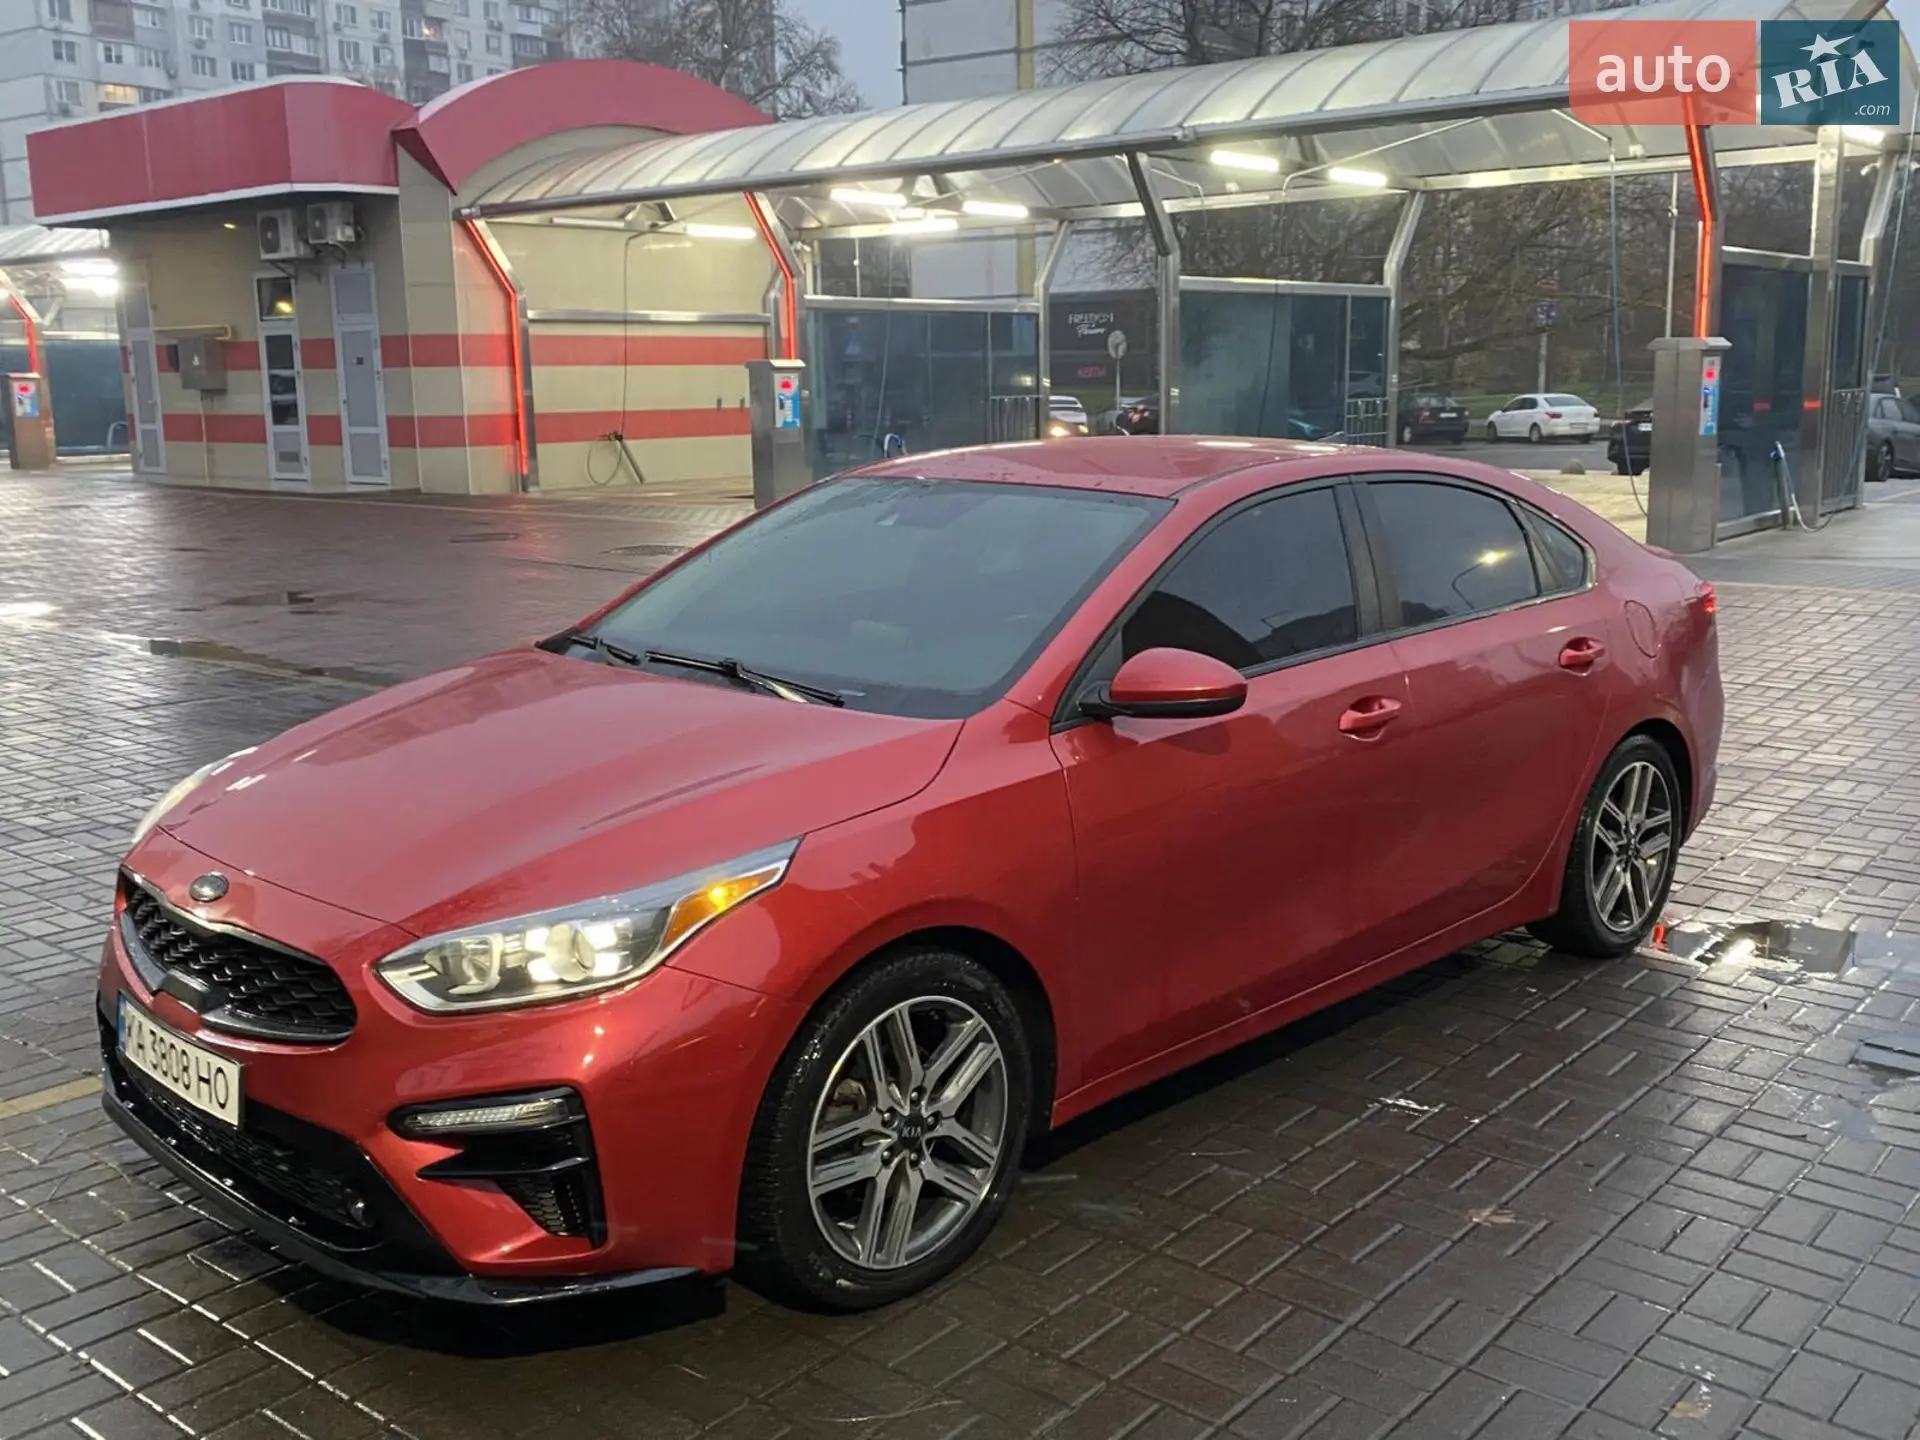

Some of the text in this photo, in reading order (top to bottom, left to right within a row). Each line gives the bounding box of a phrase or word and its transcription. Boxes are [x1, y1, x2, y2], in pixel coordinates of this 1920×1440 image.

[126, 1014, 230, 1110] KA 3808 HO
[901, 1126, 922, 1138] KIA
